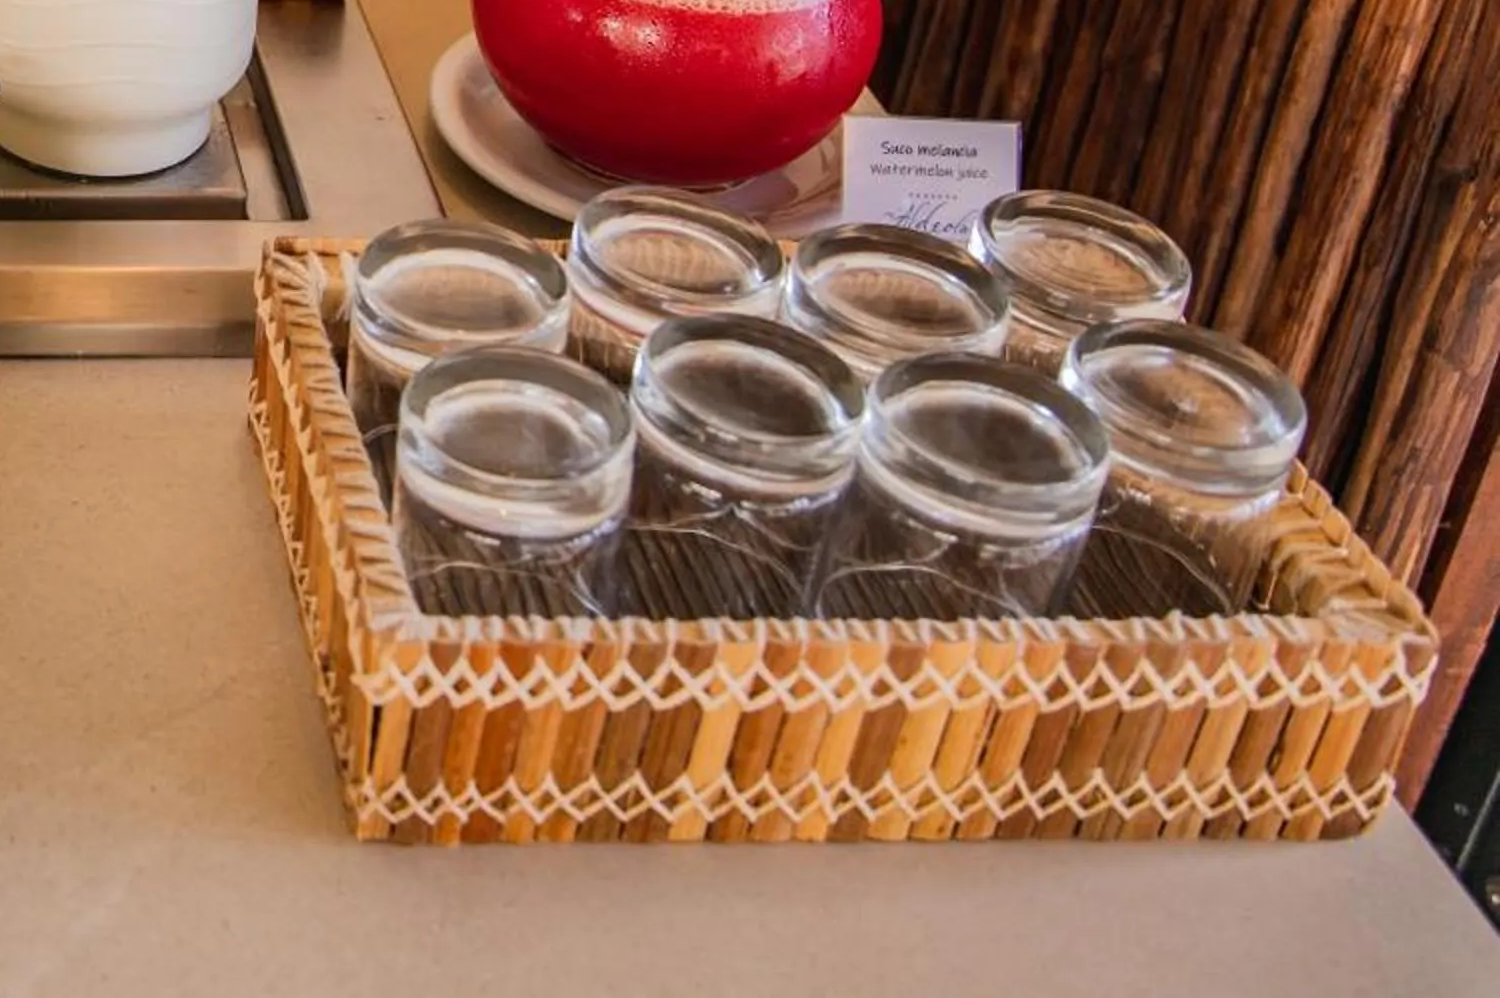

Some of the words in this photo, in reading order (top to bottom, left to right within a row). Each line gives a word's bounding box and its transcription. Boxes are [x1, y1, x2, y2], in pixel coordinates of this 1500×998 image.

[880, 140, 914, 156] Suco
[917, 142, 978, 159] melancia
[869, 163, 953, 179] Watermelon
[956, 168, 989, 182] juice
